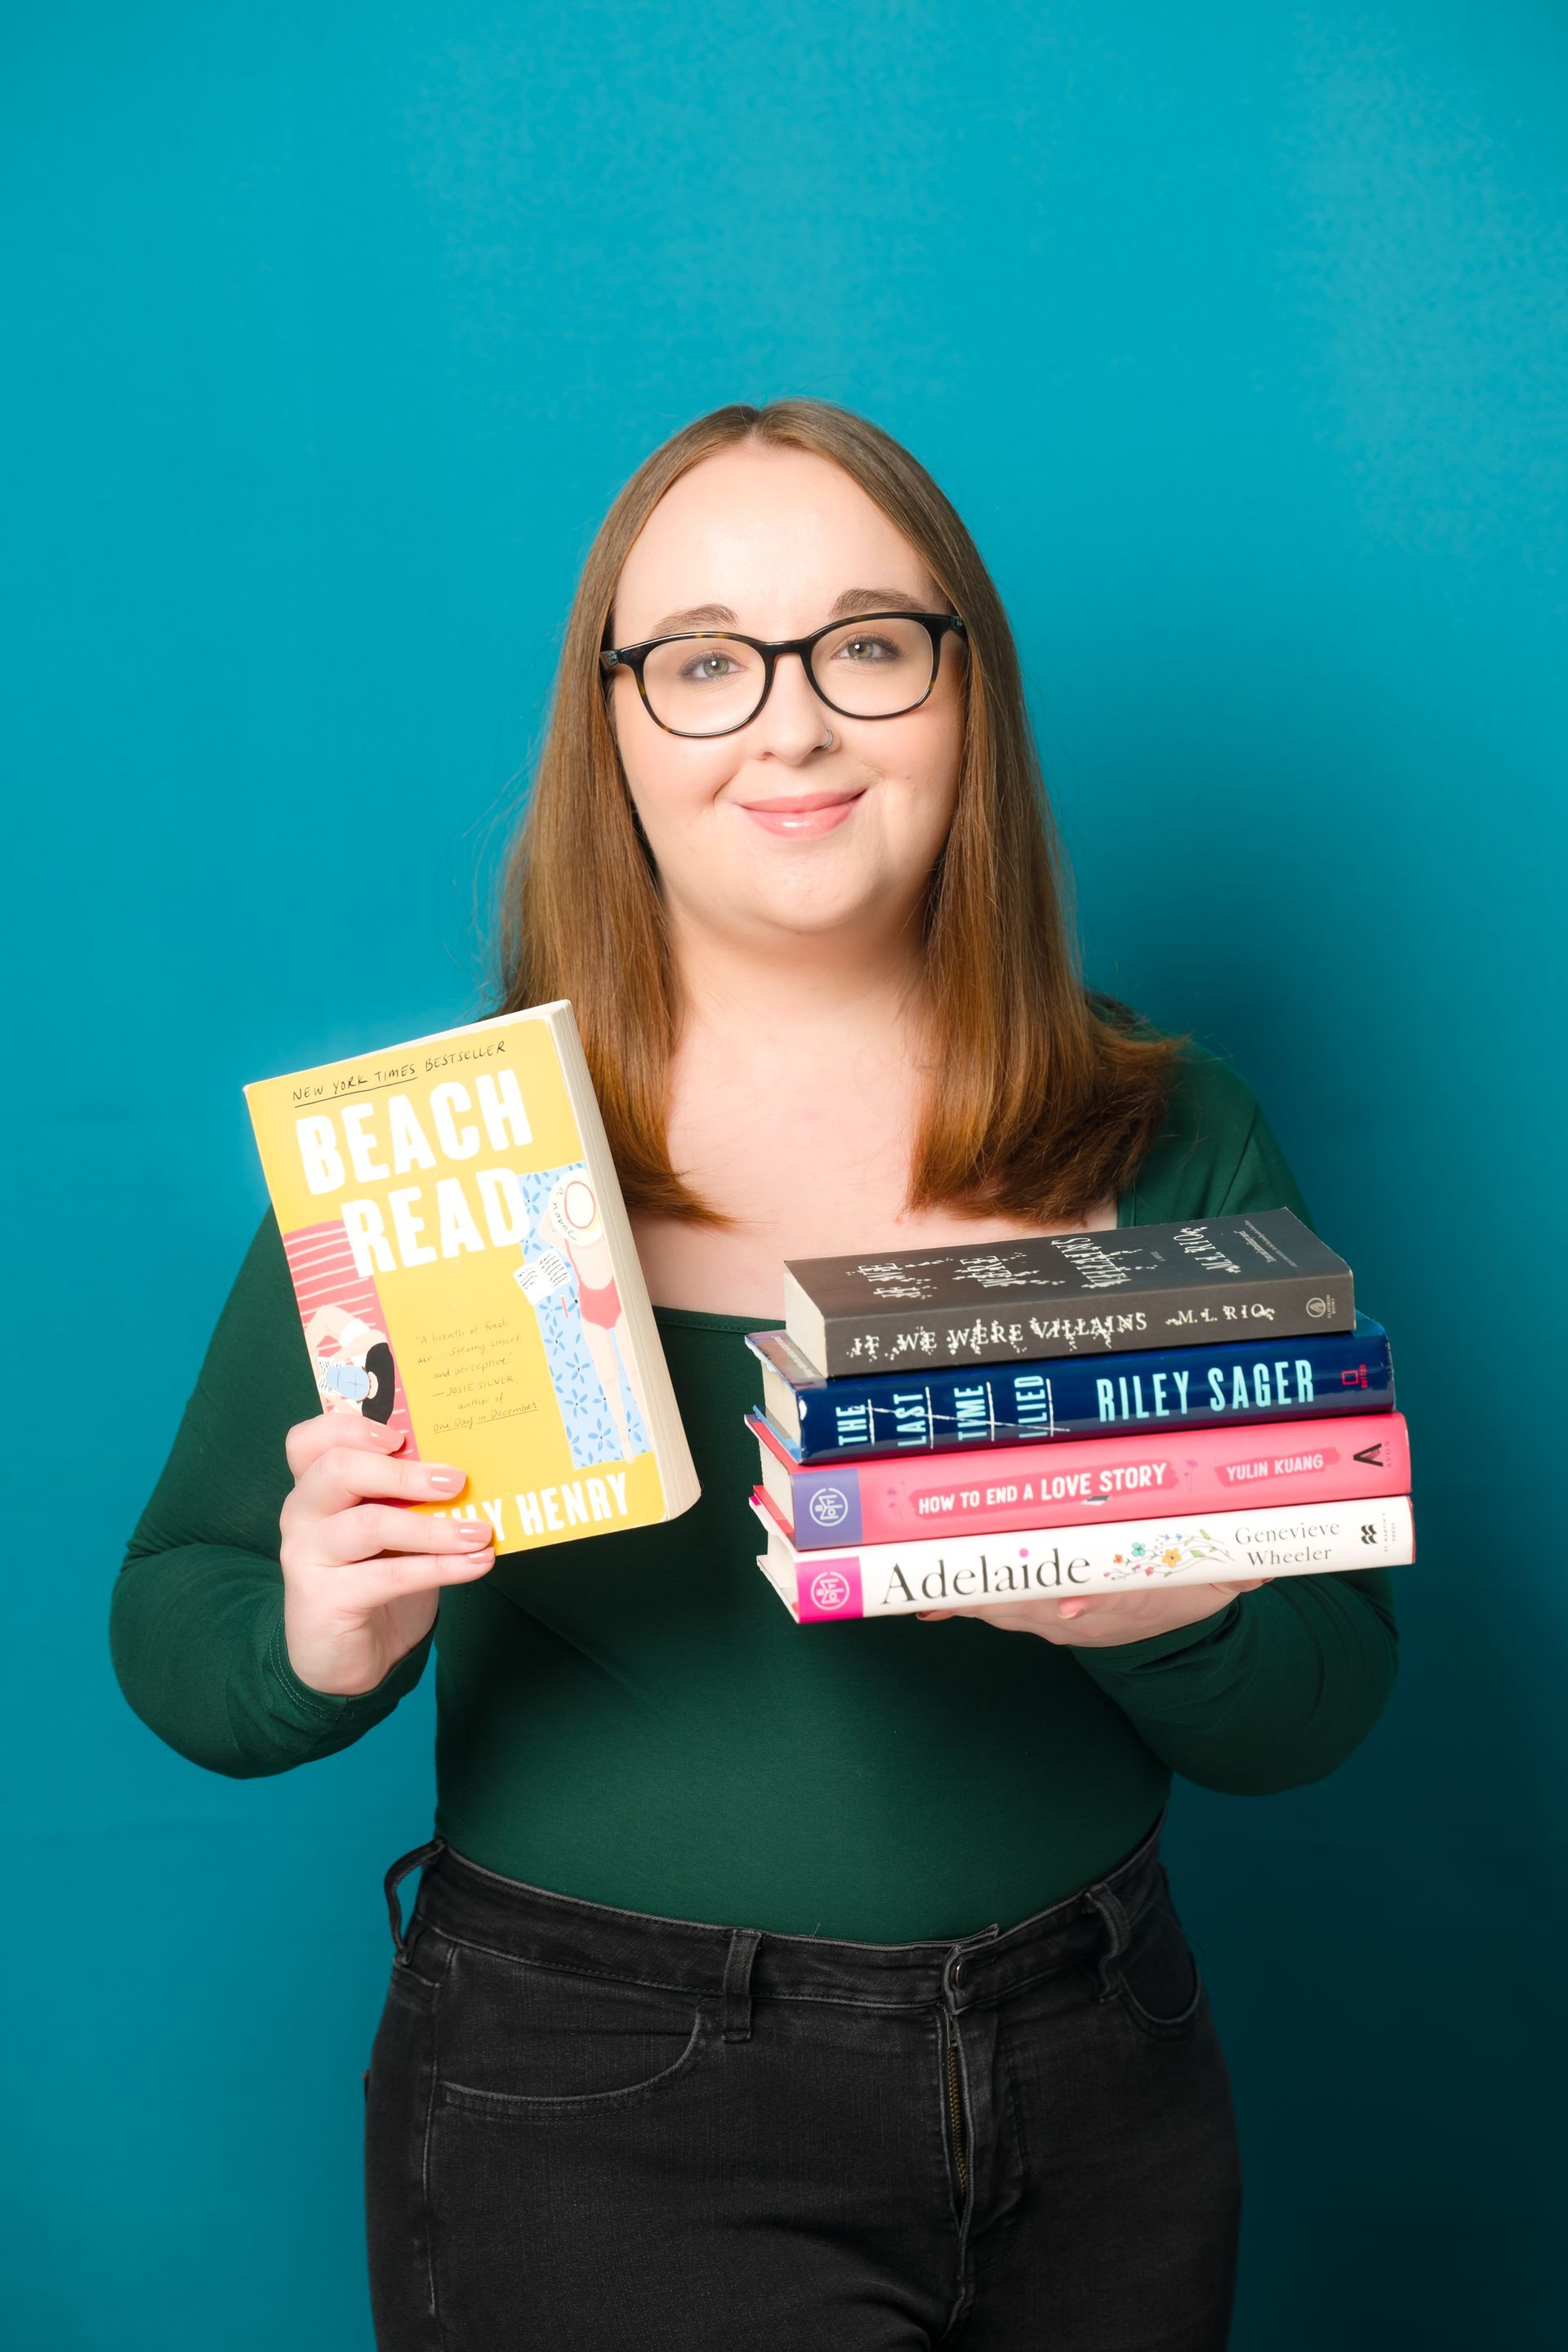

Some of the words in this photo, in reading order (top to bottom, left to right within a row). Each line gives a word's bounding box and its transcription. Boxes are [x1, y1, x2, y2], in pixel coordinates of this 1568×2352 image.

[292, 1085, 323, 1101] NEW
[332, 1075, 368, 1094] YORK
[375, 1063, 416, 1083] TIMES
[425, 1040, 506, 1072] BESTSELLER
[296, 1068, 533, 1195] BEACH
[341, 1168, 531, 1278] READ
[553, 1202, 577, 1241] novel
[431, 1330, 465, 1342] breath
[470, 1326, 479, 1334] of
[485, 1320, 509, 1331] fresh
[847, 1335, 880, 1361] IF
[895, 1328, 937, 1357] WE
[947, 1319, 1025, 1354] WERE
[1031, 1312, 1147, 1351] VILLAINS
[1223, 1304, 1274, 1321] RIO
[434, 1370, 450, 1379] and
[1013, 1375, 1048, 1423] LIED
[1096, 1370, 1188, 1423] RILEY
[1208, 1360, 1314, 1412] SAGER
[454, 1417, 473, 1429] Day
[491, 1401, 537, 1419] December
[458, 1397, 489, 1410] author
[495, 1392, 505, 1404] of
[835, 1405, 868, 1446] THE
[893, 1394, 927, 1446] LAST
[954, 1385, 987, 1441] TIME
[919, 1494, 956, 1515] HOW
[960, 1490, 980, 1508] TO
[986, 1486, 1018, 1506] END
[1023, 1484, 1034, 1500] A
[1040, 1473, 1092, 1501] LOVE
[1099, 1463, 1167, 1493] STORY
[1227, 1462, 1268, 1481] YULIN
[1274, 1454, 1324, 1474] KUANG
[515, 1472, 628, 1535] HENRY
[1235, 1522, 1339, 1545] Genevieve
[1247, 1546, 1332, 1566] Wheeler
[881, 1548, 1091, 1605] Adelaide
